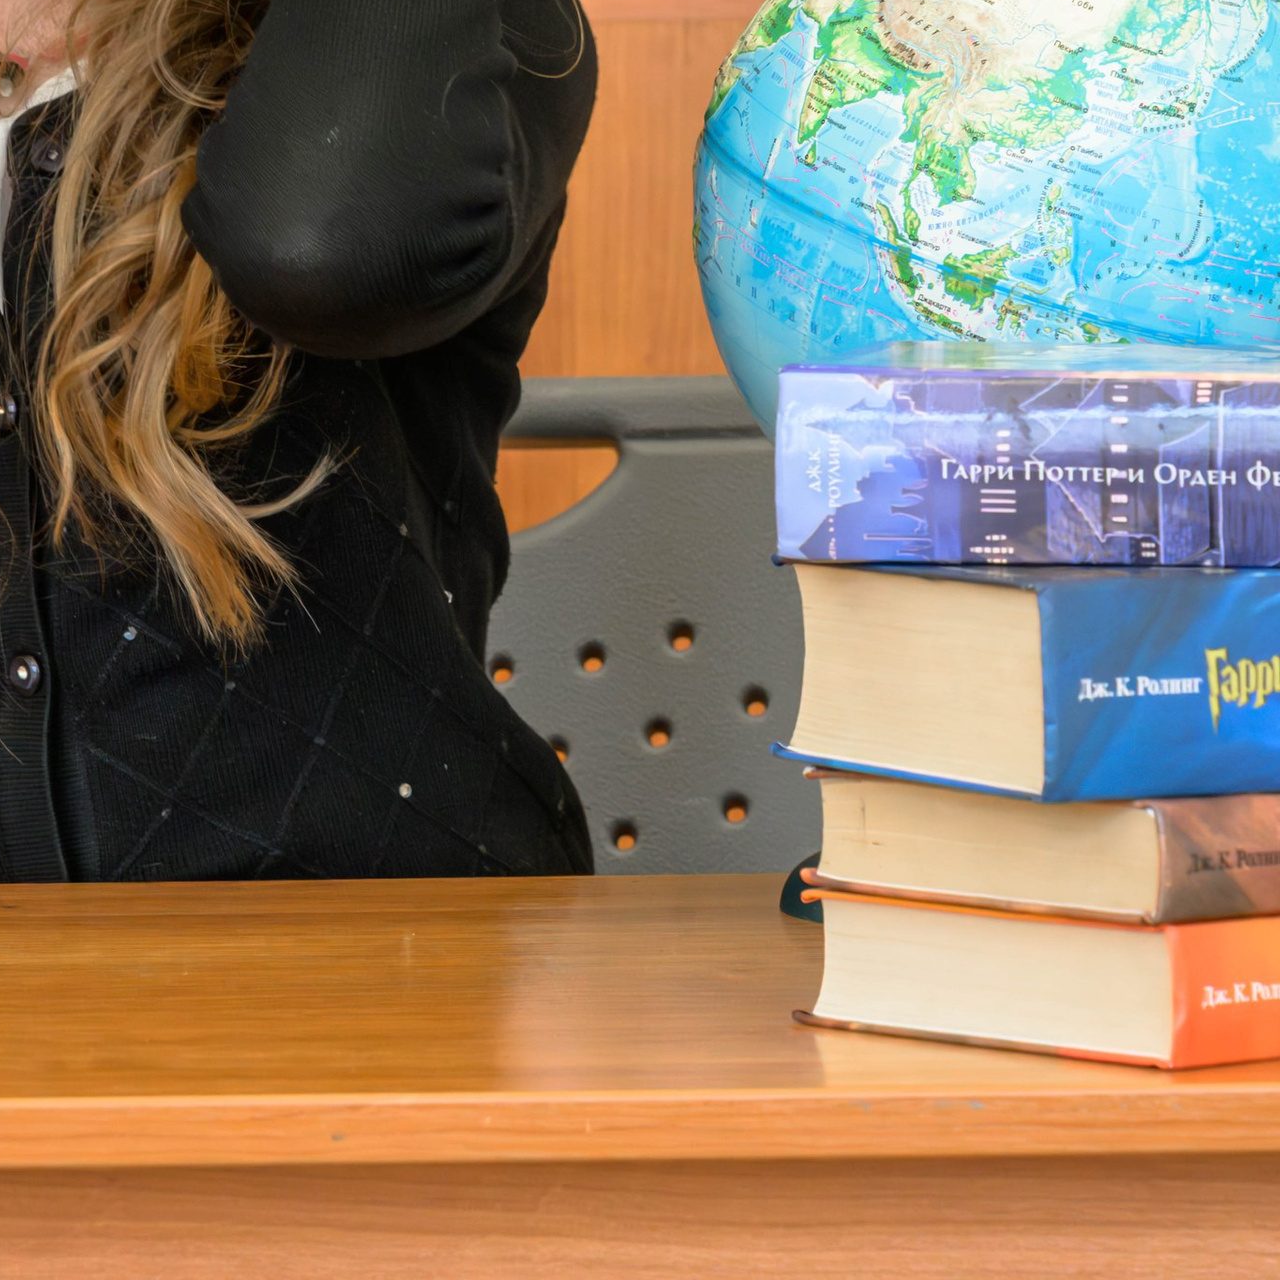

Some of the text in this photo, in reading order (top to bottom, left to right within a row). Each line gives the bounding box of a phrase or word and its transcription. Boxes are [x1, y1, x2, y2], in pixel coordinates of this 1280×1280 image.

[1053, 39, 1080, 56] Пекин
[1005, 149, 1034, 164] Сянган
[1053, 206, 1084, 220] Манила
[1078, 676, 1203, 702] Дж. К. Ролинг
[1202, 985, 1232, 1010] Дж.
